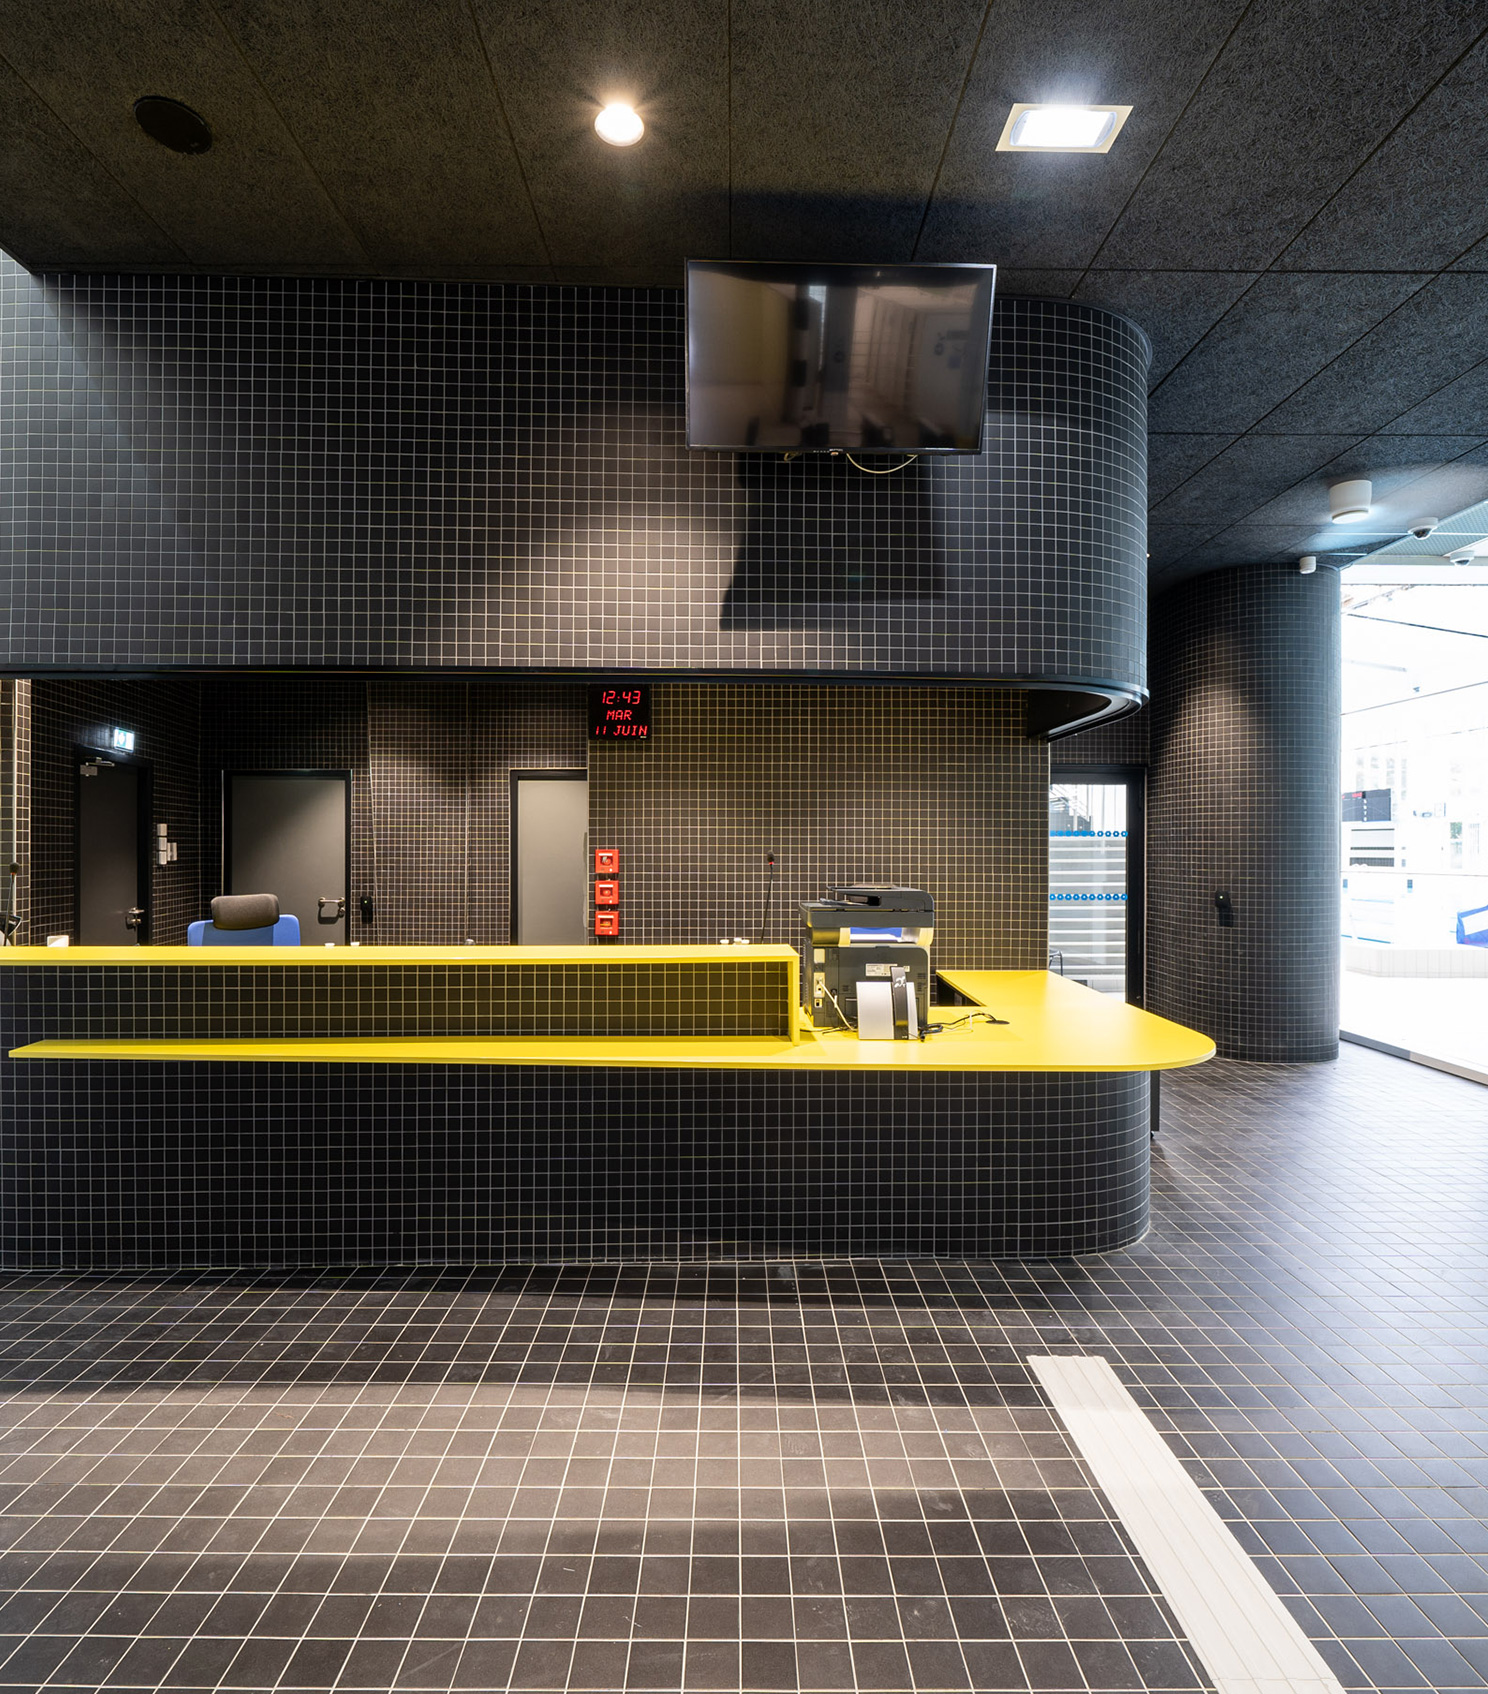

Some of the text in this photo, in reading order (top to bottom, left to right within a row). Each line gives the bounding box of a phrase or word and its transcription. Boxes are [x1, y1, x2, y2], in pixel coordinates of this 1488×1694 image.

[601, 690, 642, 705] 12:43
[605, 709, 633, 721] MAR
[595, 724, 648, 736] 11 JUIN
